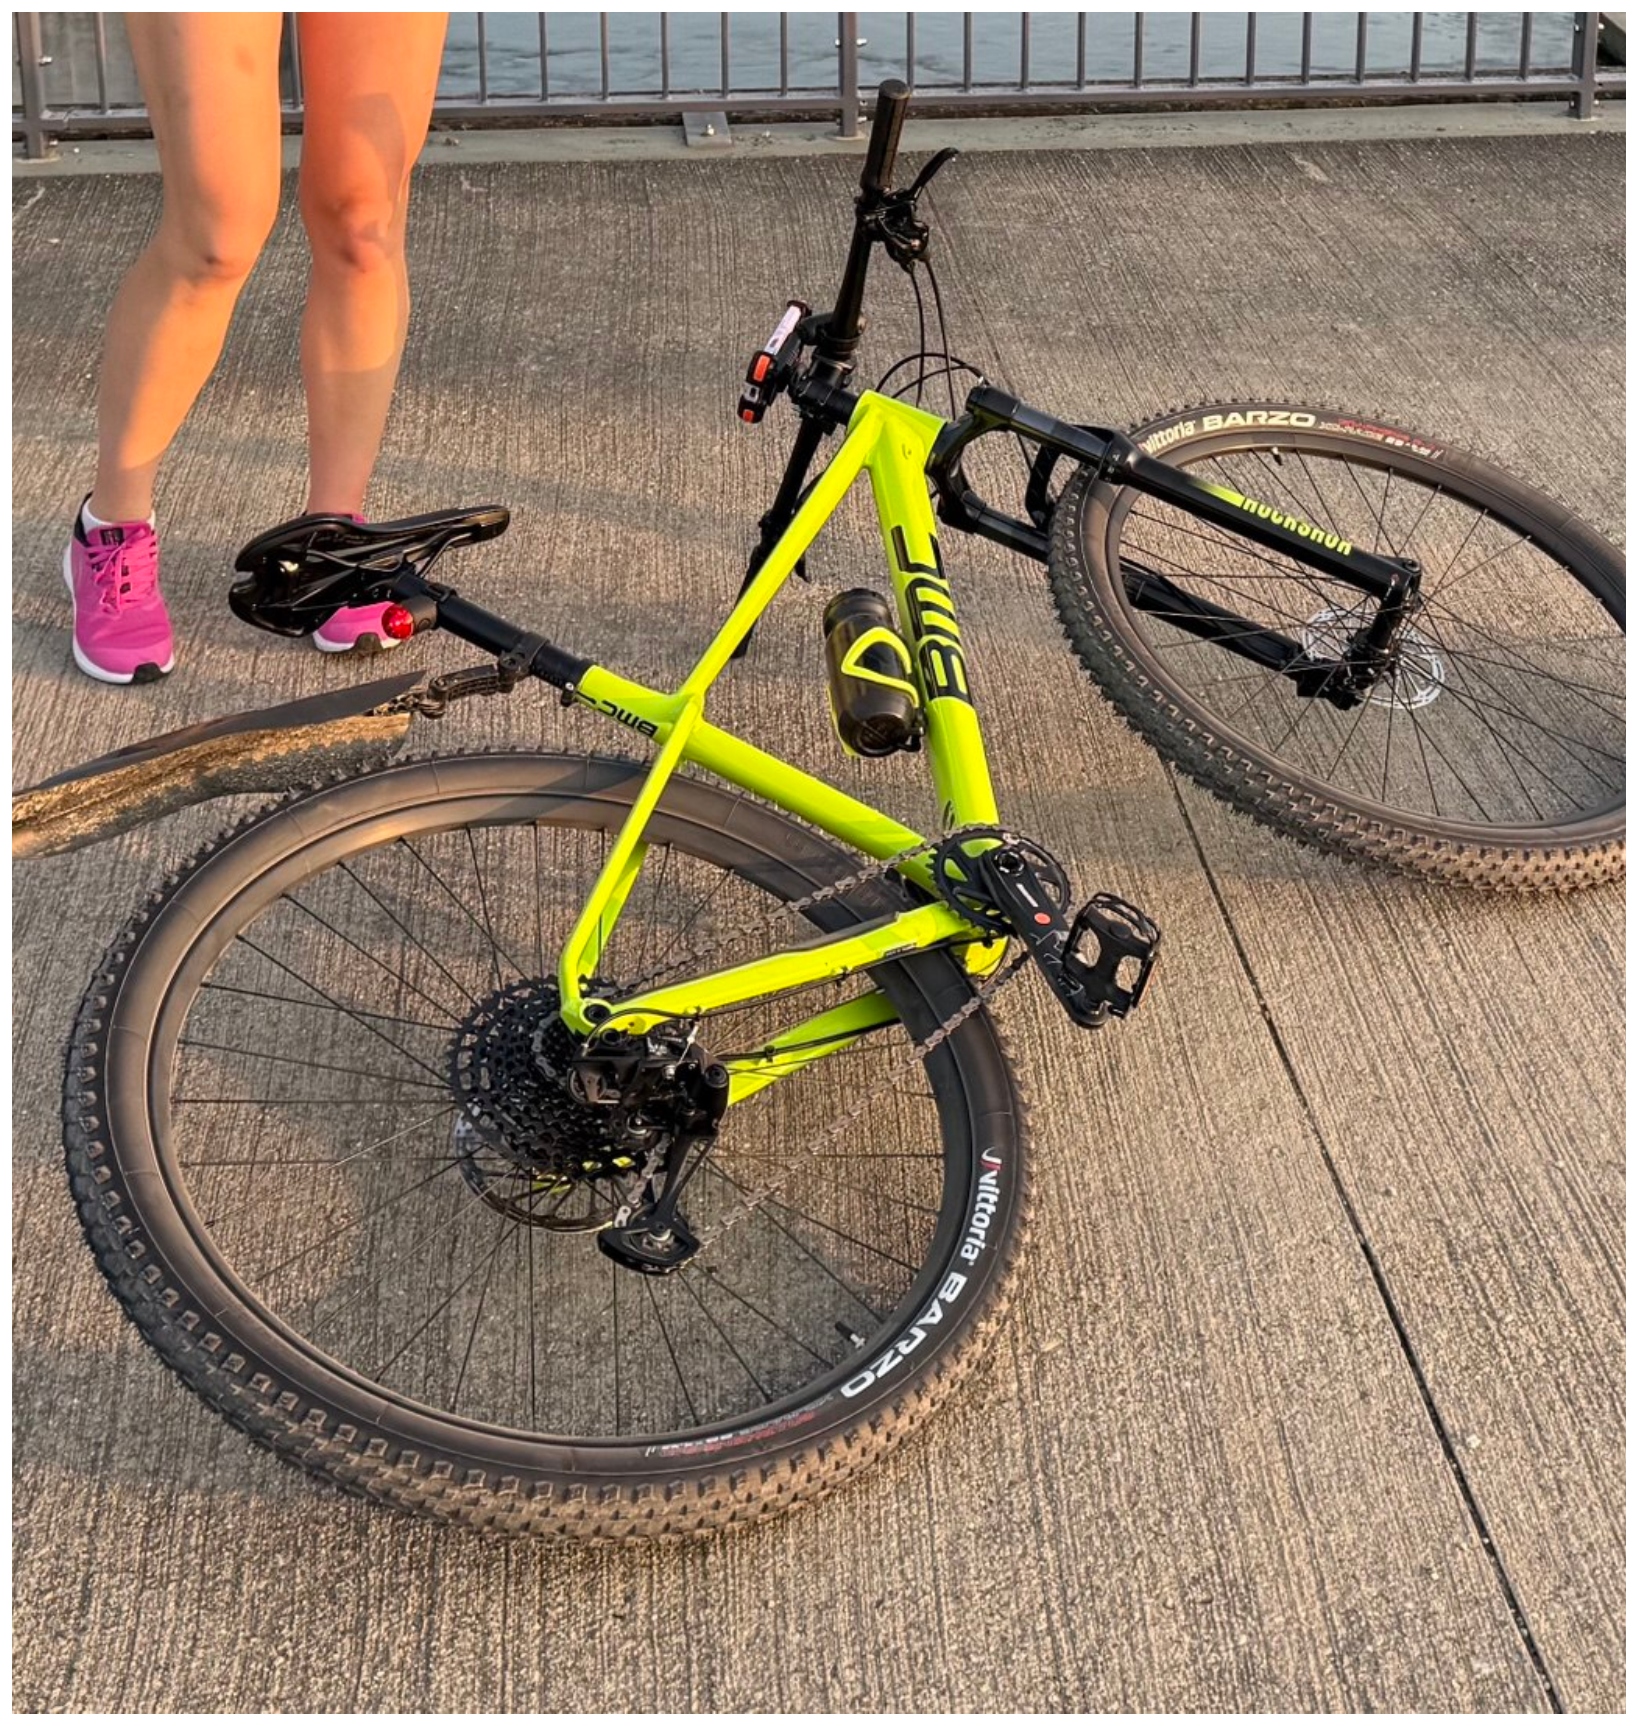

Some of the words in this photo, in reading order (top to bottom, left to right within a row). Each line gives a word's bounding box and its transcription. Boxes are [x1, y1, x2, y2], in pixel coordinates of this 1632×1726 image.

[1202, 411, 1316, 431] BARZO
[891, 525, 973, 705] BMC
[598, 700, 658, 738] BMC
[960, 1170, 1001, 1263] vittoria
[840, 1272, 968, 1398] BARZO
